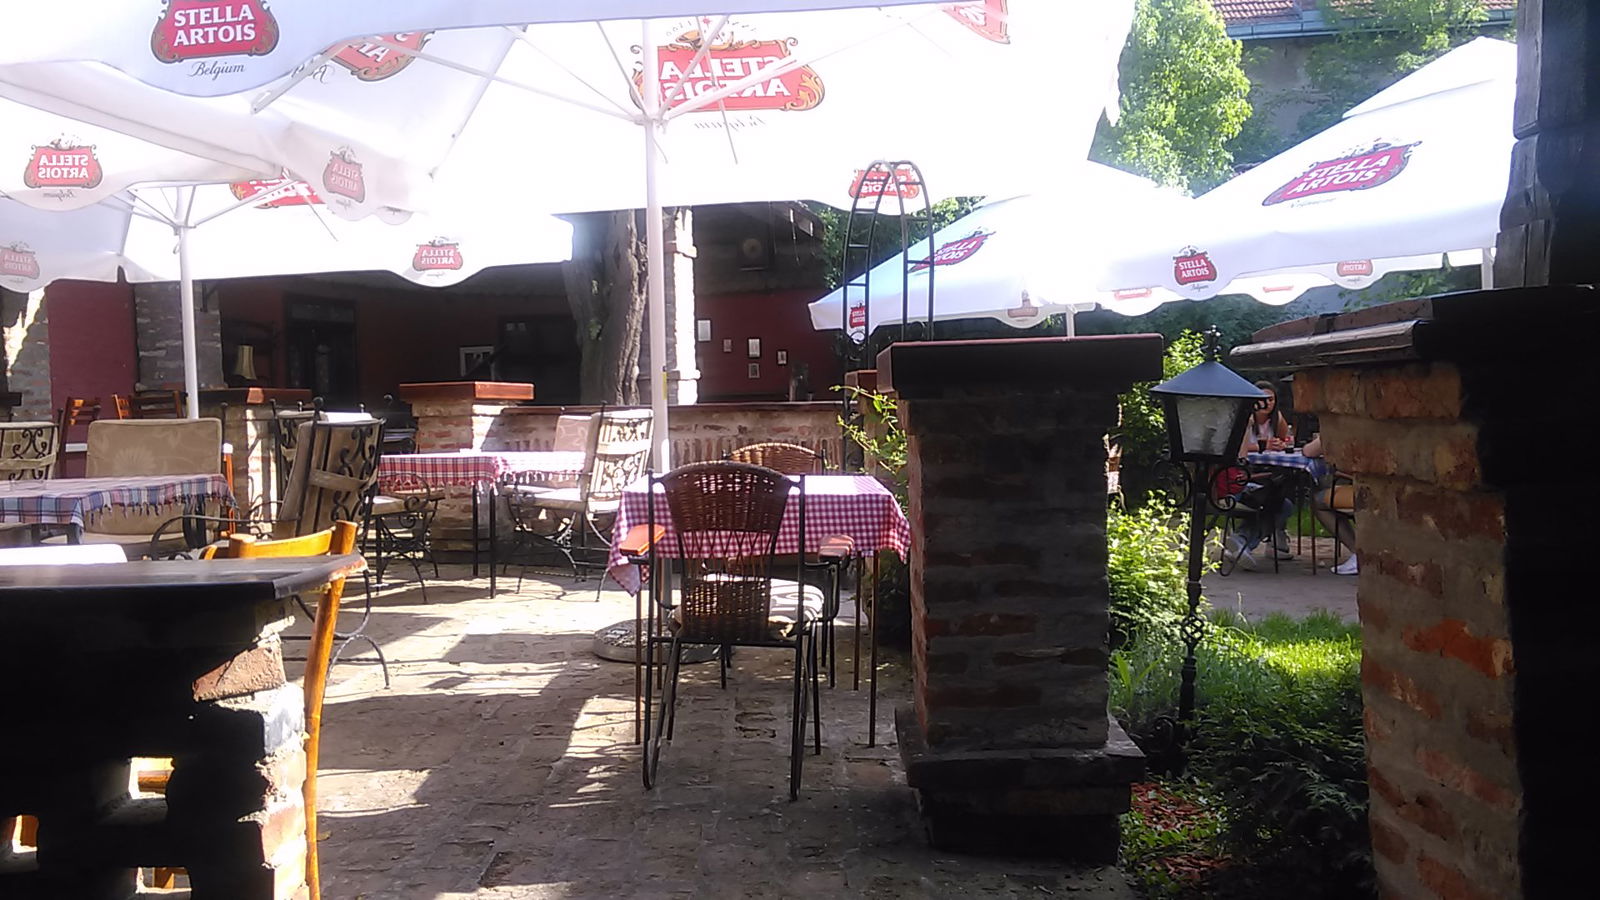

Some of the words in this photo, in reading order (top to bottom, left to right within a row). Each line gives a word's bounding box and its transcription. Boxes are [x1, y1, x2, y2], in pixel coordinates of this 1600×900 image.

[174, 4, 255, 27] STELLA
[173, 23, 256, 47] ARTOIS
[187, 60, 246, 81] Belgium
[1303, 154, 1391, 181] STELLA
[1286, 168, 1381, 195] ARTOIS
[1178, 258, 1207, 270] STELLA
[1181, 267, 1210, 278] ARTOIS
